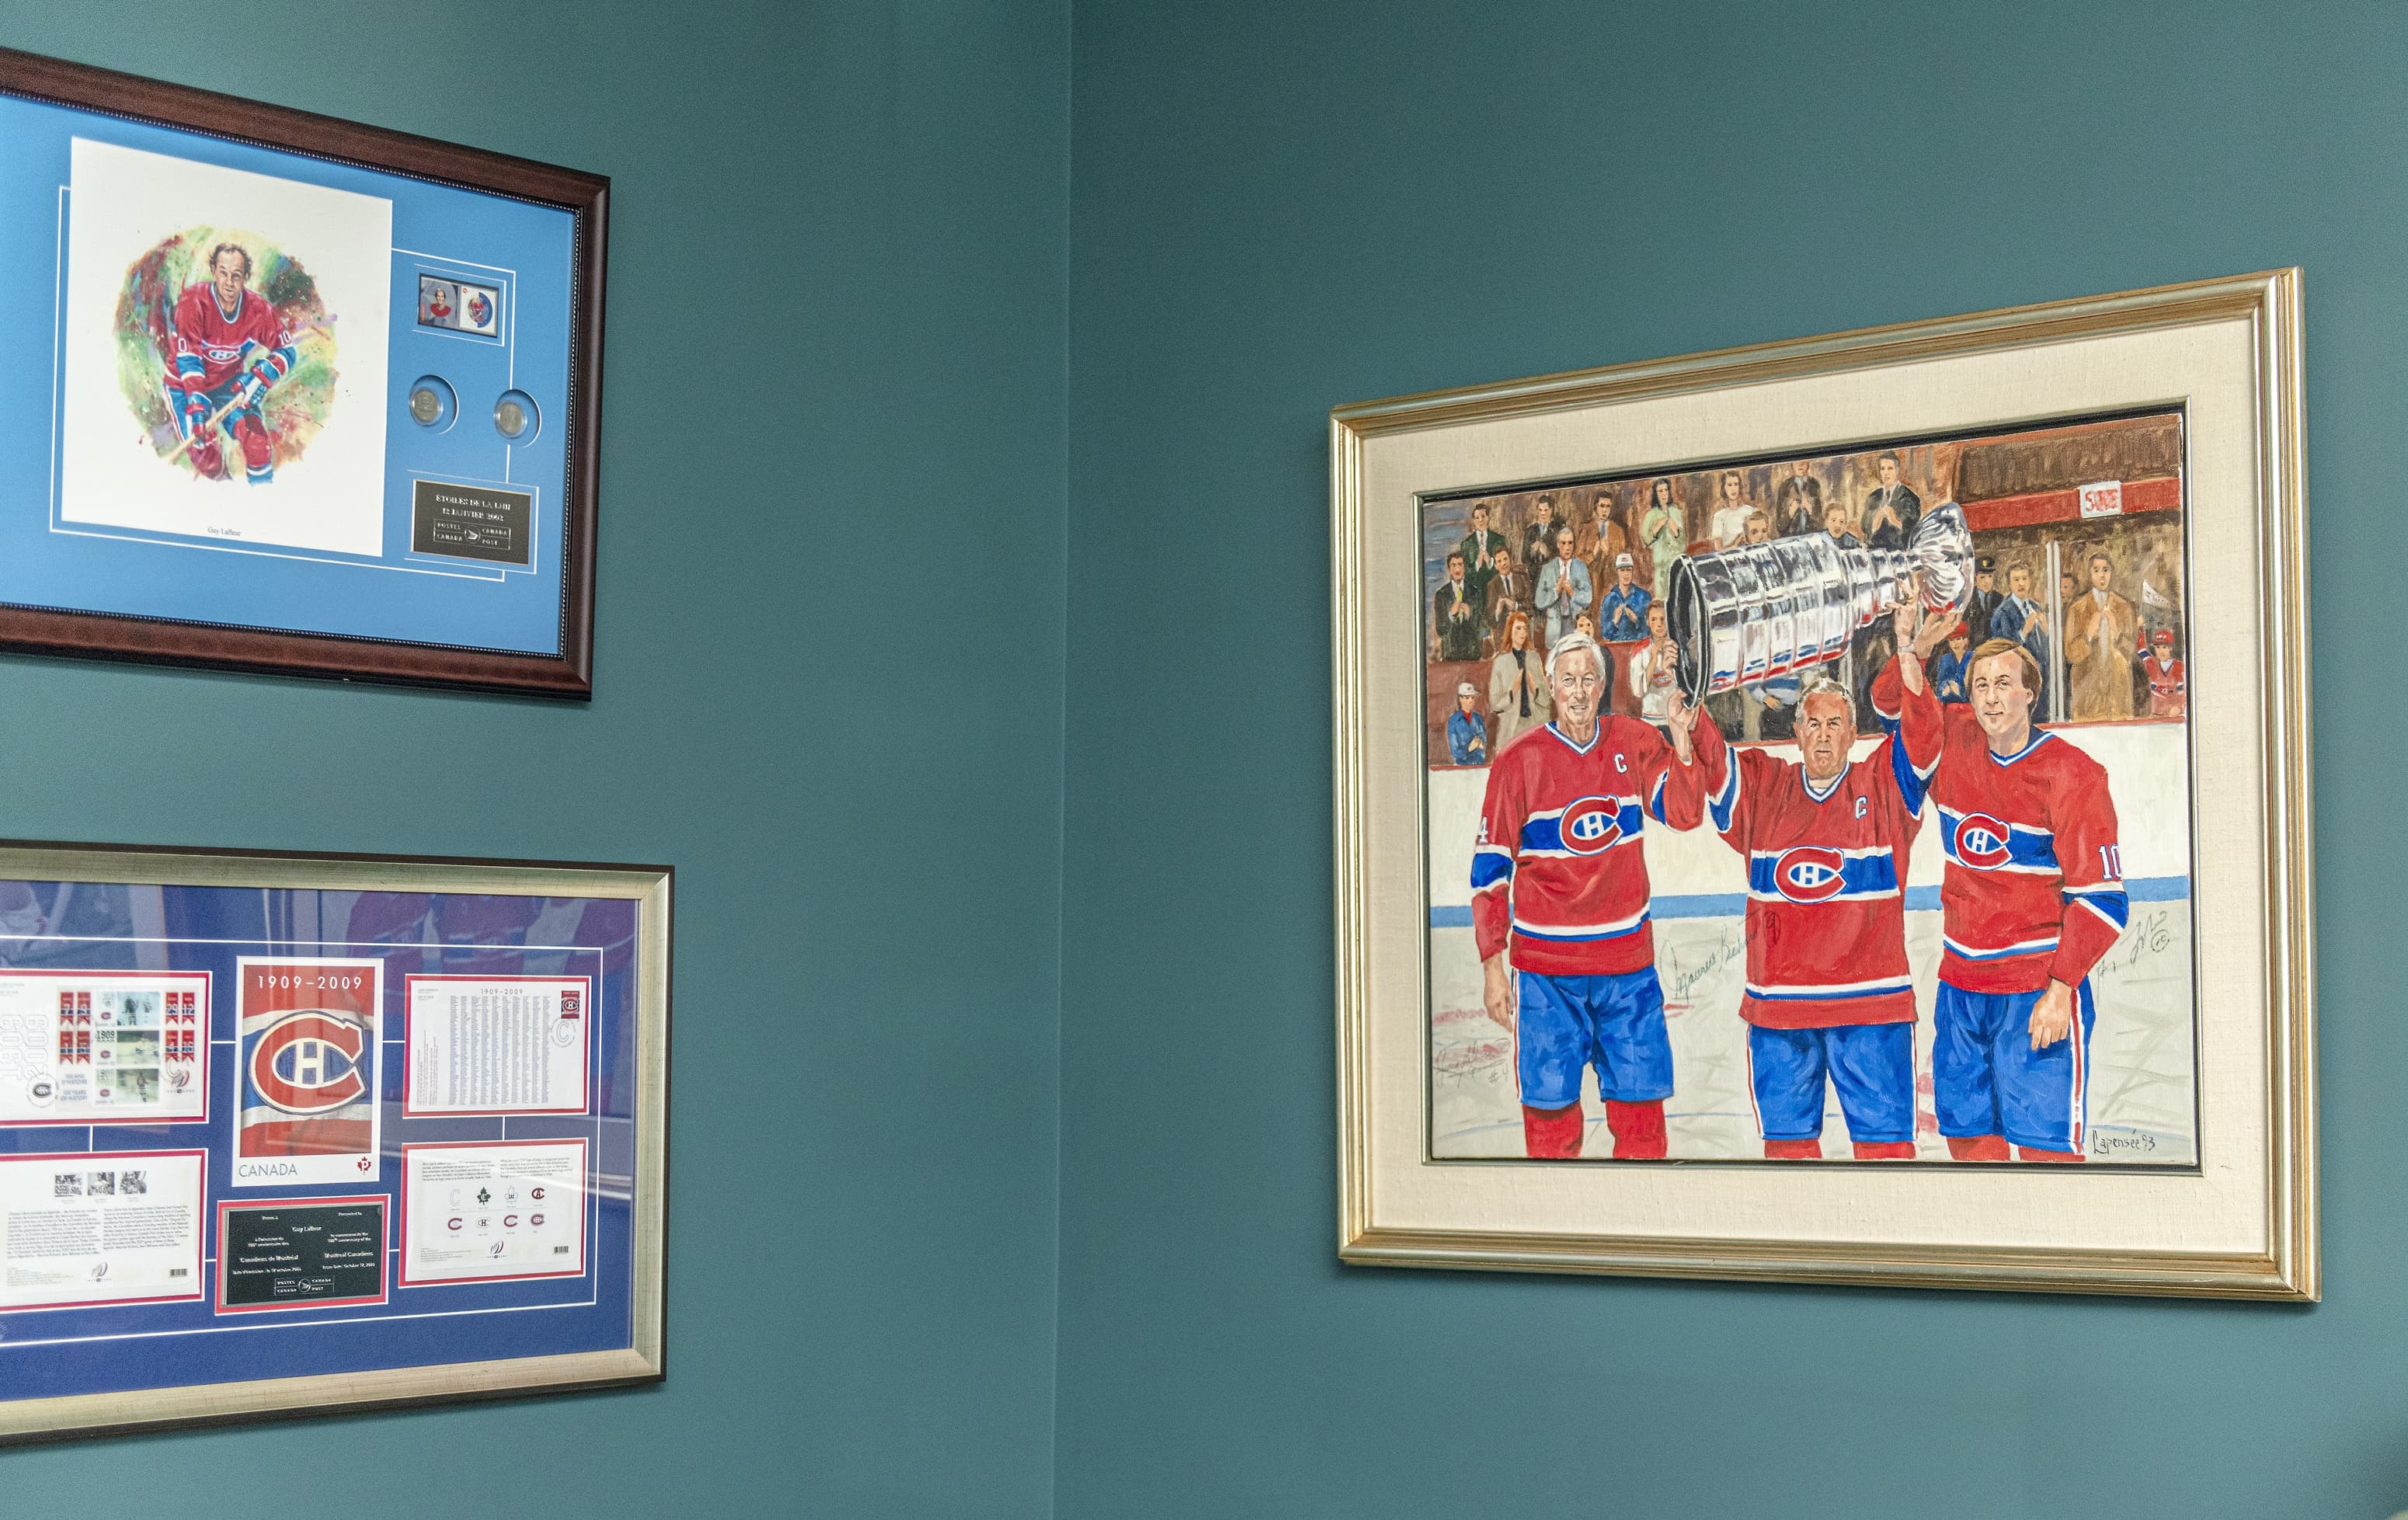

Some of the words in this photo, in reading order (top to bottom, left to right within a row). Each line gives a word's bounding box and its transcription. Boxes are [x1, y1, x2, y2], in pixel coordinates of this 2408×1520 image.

[451, 508, 485, 519] JANVIER
[1614, 753, 1628, 774] C
[1855, 795, 1868, 819] C
[238, 1163, 298, 1177] CANADA
